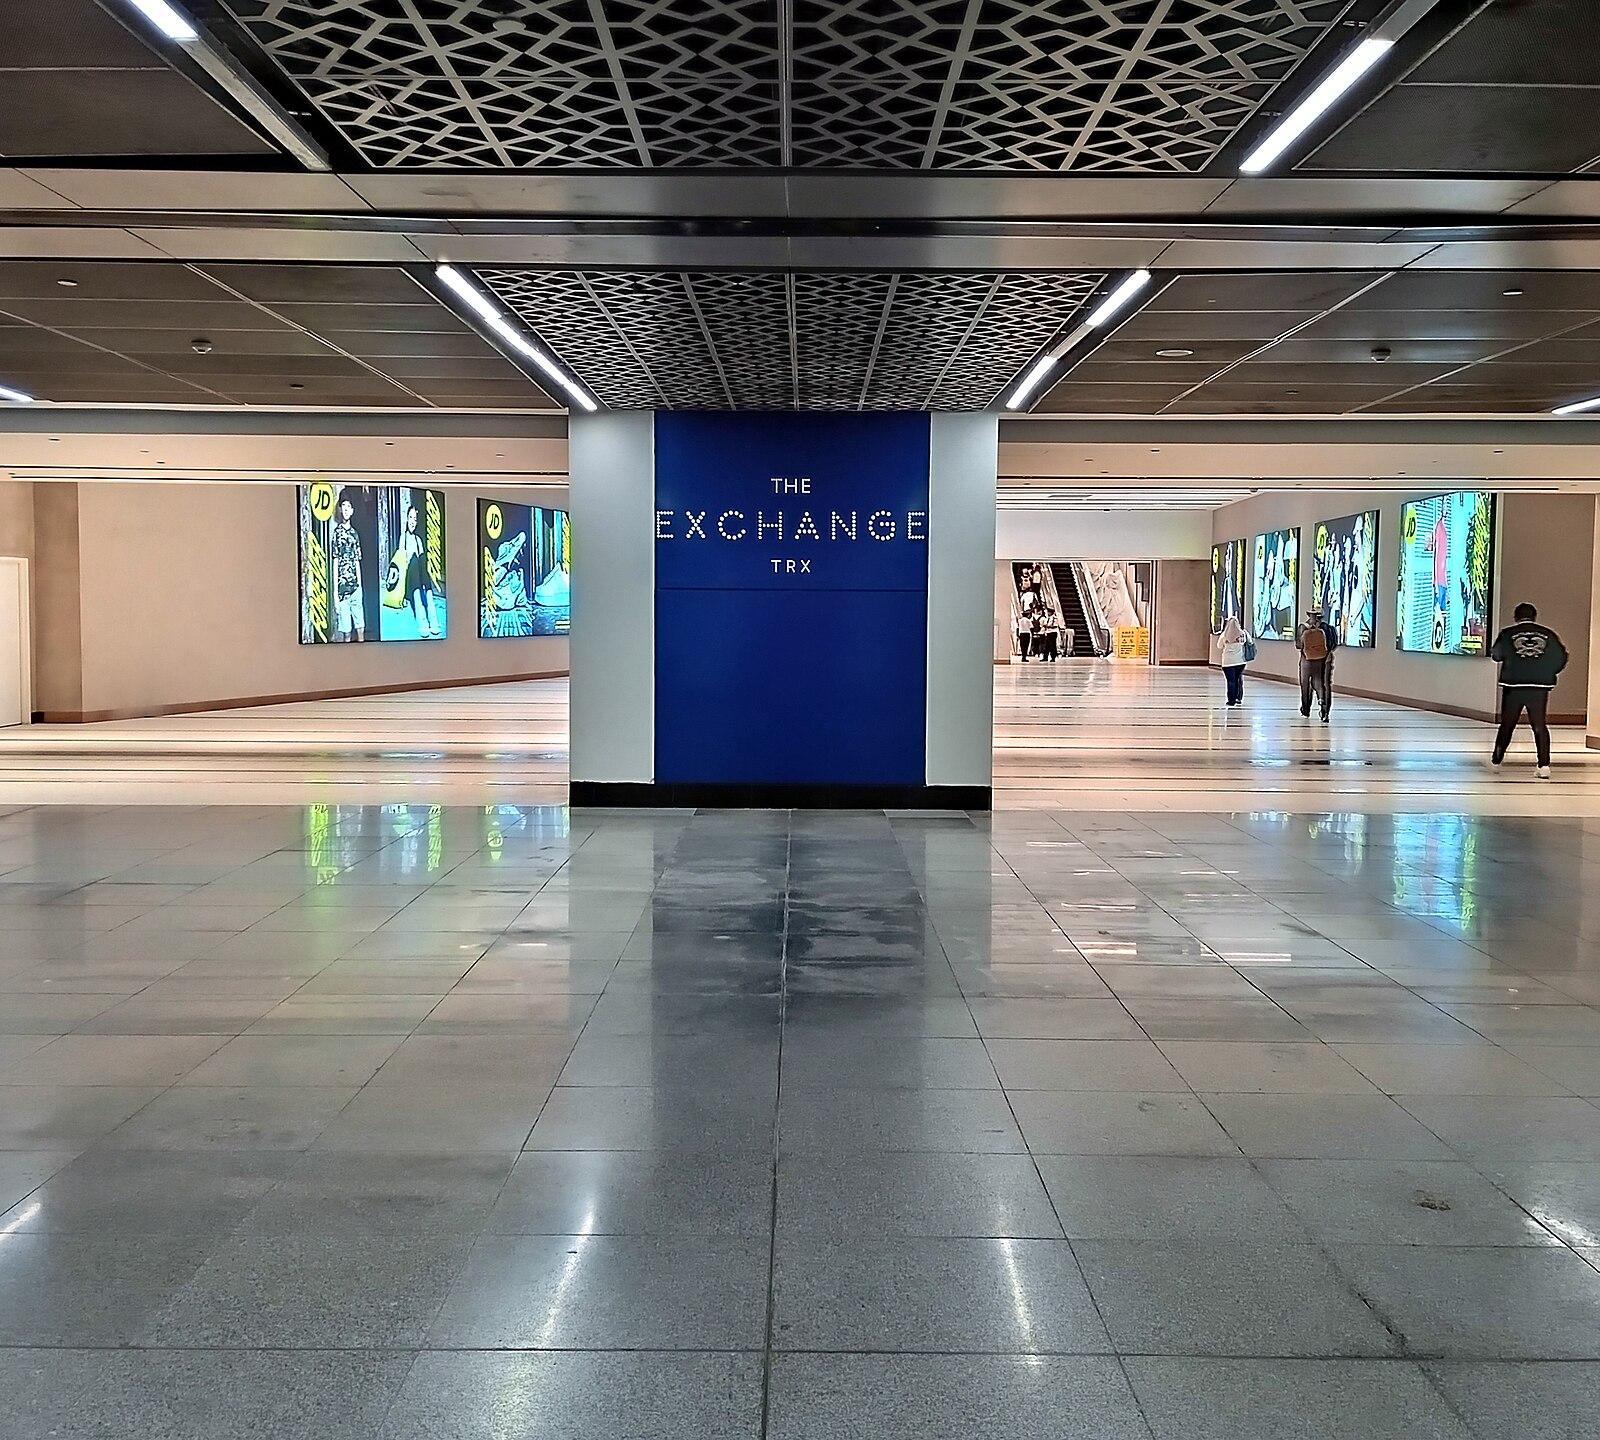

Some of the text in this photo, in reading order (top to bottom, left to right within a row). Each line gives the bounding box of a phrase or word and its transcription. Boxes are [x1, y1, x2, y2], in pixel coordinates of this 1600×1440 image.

[770, 478, 811, 494] THE
[314, 489, 331, 511] JD
[489, 513, 500, 530] JD
[656, 510, 926, 541] EXCHANGE
[1405, 516, 1416, 538] JD
[770, 559, 811, 573] TRX
[307, 530, 329, 643] FOREVER
